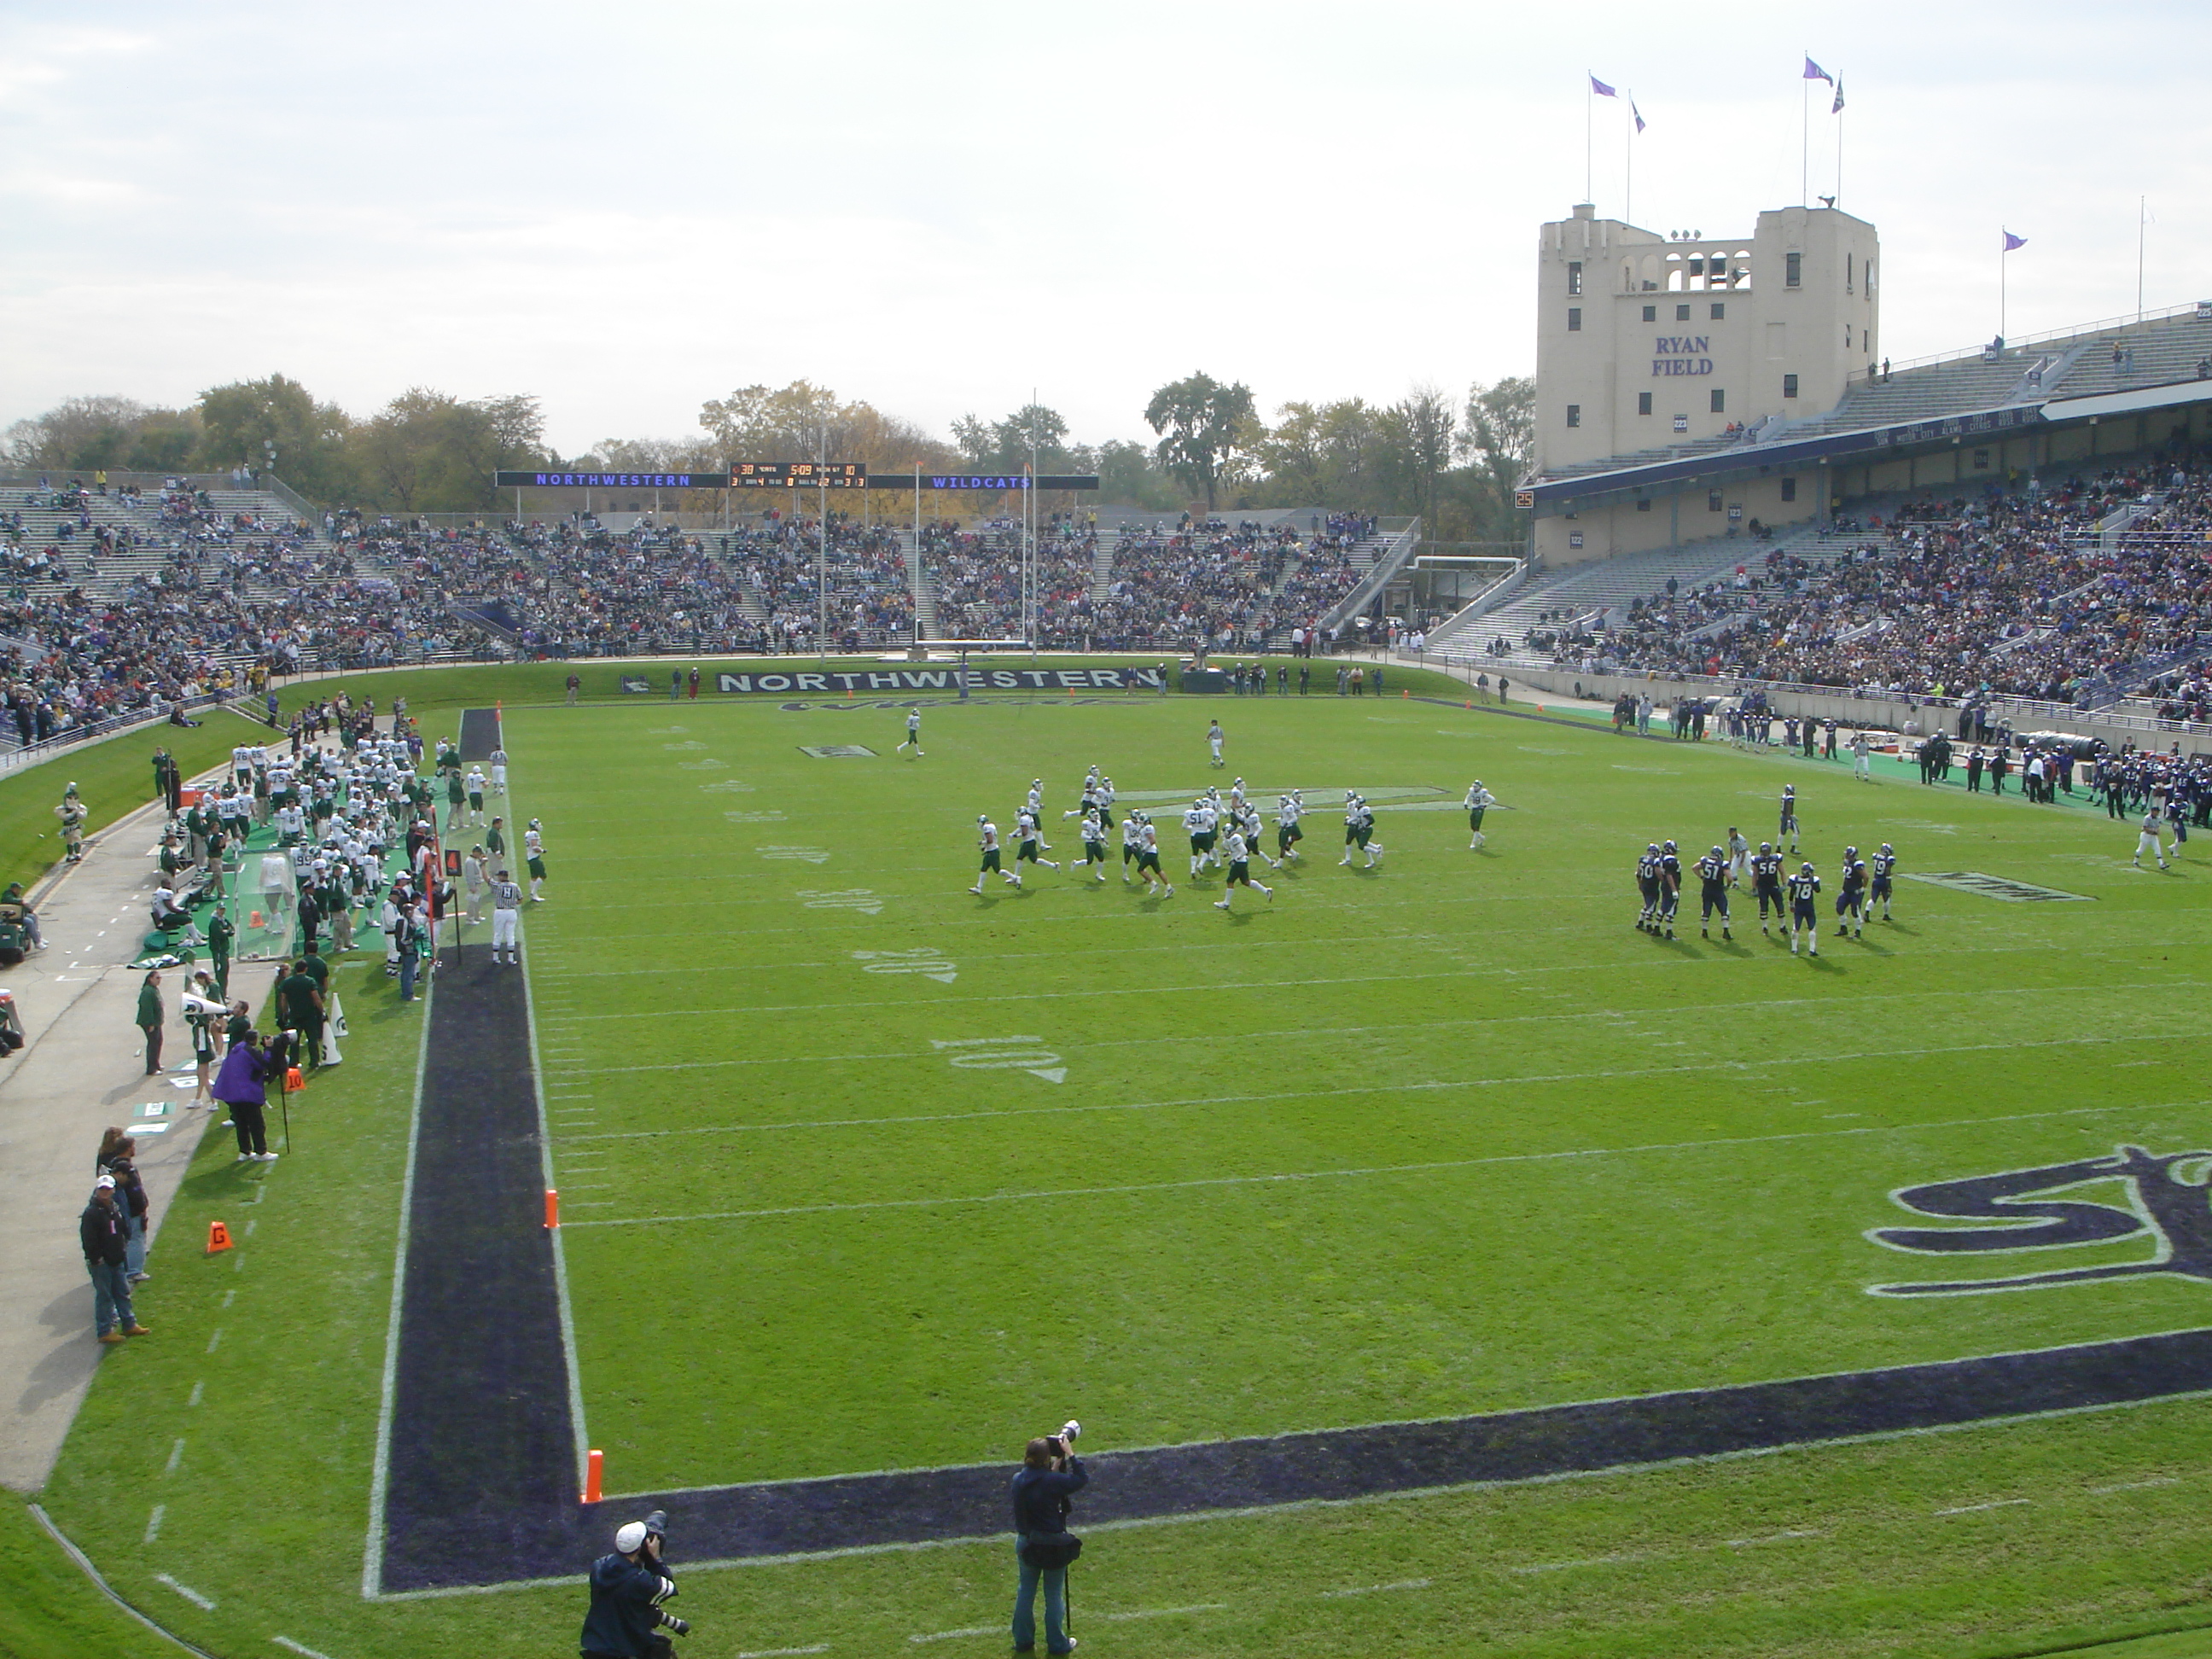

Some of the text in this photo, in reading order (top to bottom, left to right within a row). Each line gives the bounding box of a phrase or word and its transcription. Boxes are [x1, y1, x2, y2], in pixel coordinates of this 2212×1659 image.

[1656, 335, 1709, 354] RYAN
[1651, 358, 1714, 376] FIELD
[1941, 424, 1963, 435] ALAMO
[790, 464, 812, 475] 5:09
[845, 465, 855, 475] 10
[166, 479, 177, 488] 115
[537, 474, 690, 486] NORTHWESTERN
[933, 477, 1030, 489] WILDCATS
[1516, 493, 1533, 506] 25
[1729, 509, 1741, 517] 123
[1571, 536, 1582, 544] 122
[720, 669, 1160, 692] NORTHWESTERN
[236, 752, 247, 760] 76
[272, 774, 285, 783] 75
[224, 804, 235, 812] 12
[289, 816, 295, 824] 8
[1190, 812, 1202, 824] 51
[296, 856, 311, 866] 99
[447, 852, 457, 870] 4
[1639, 863, 1654, 878] 50
[1703, 864, 1720, 880] 51
[1759, 861, 1777, 875] 56
[1874, 860, 1886, 875] 19
[503, 887, 511, 899] H
[1795, 883, 1812, 899] 18
[288, 1076, 301, 1088] 10
[212, 1226, 227, 1243] G
